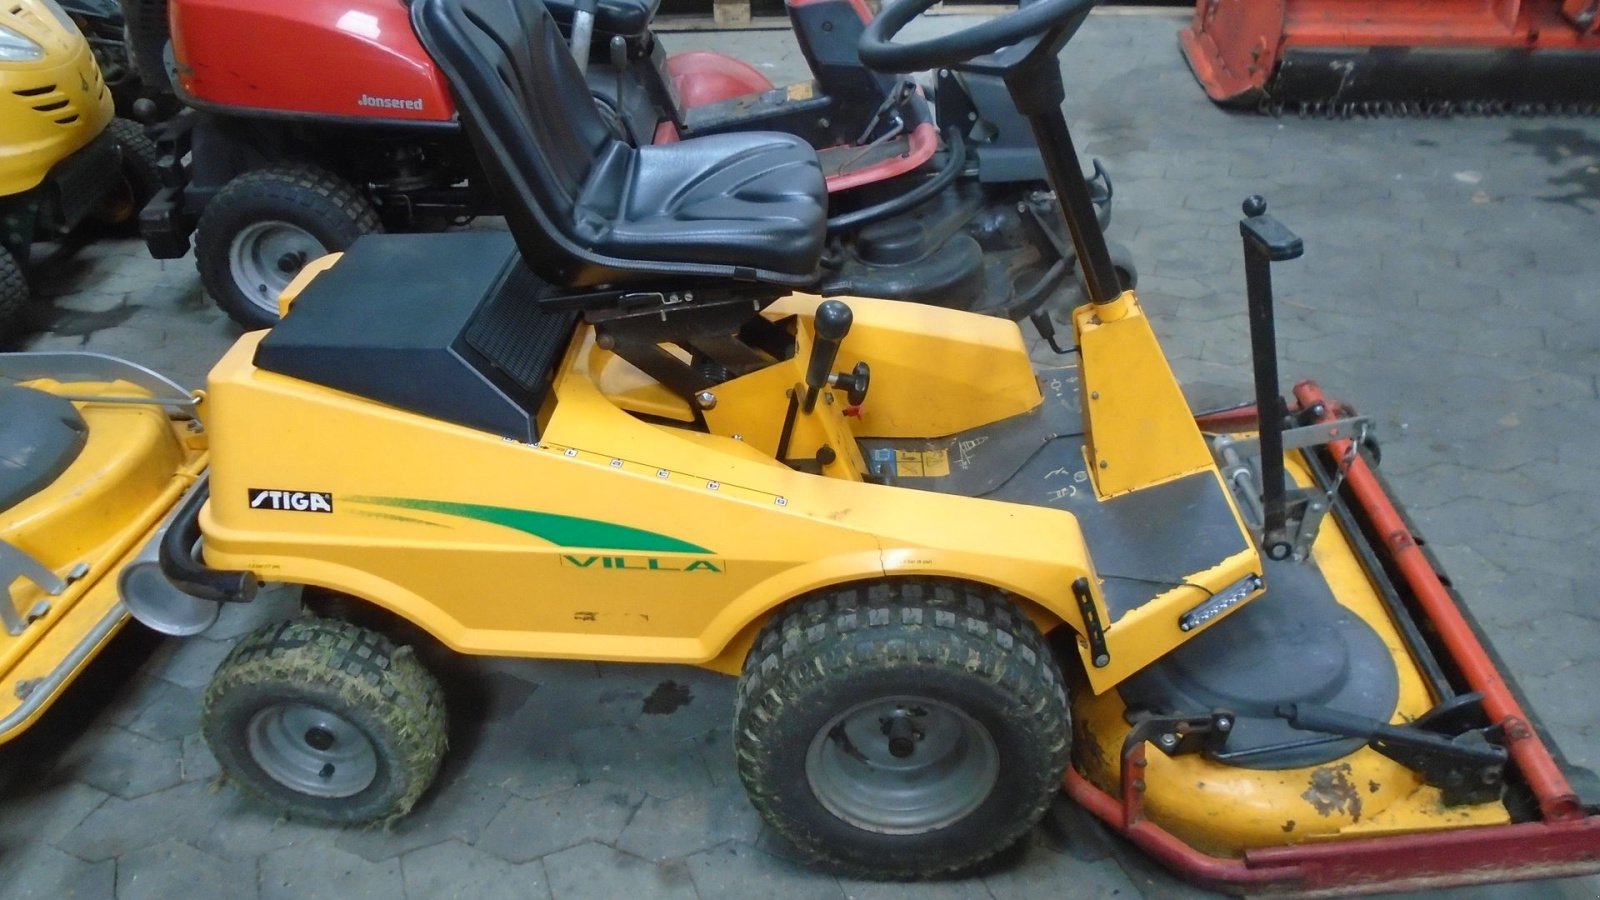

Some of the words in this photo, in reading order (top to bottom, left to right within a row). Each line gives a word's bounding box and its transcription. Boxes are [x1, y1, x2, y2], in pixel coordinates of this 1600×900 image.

[358, 94, 423, 111] Jonsered
[251, 490, 331, 512] STIGA
[563, 554, 722, 573] VILLA
